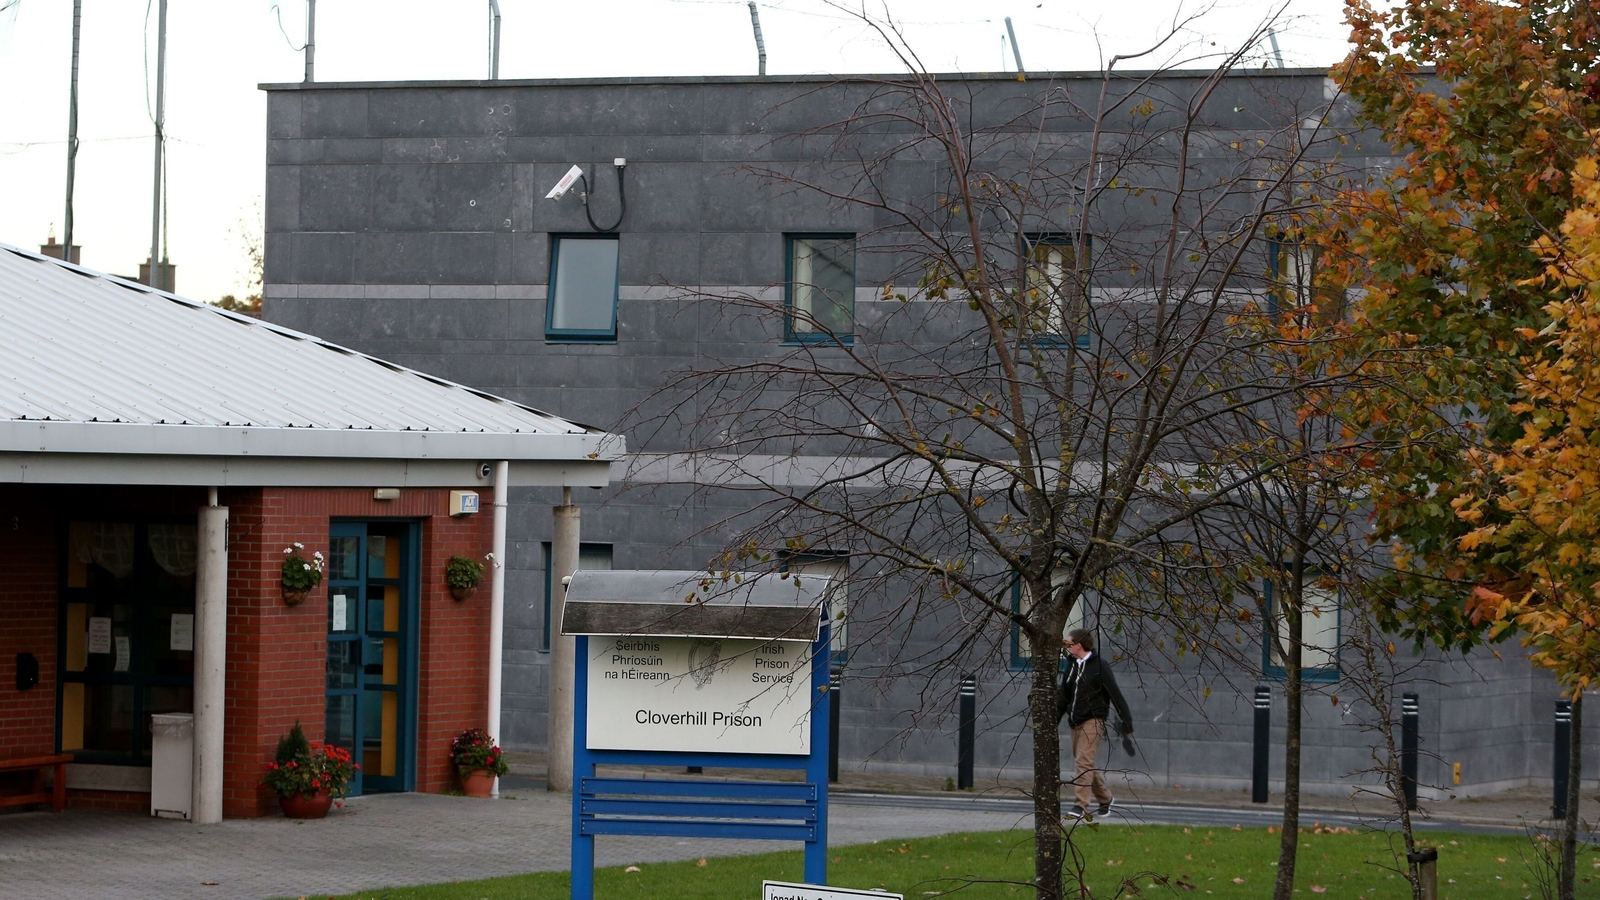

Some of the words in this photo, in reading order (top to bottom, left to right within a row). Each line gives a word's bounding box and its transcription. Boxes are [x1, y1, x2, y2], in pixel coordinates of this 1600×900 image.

[762, 644, 785, 655] Irish
[755, 658, 790, 669] Prison
[605, 672, 618, 680] na
[621, 667, 670, 681] hÉireann
[752, 672, 794, 684] Service
[635, 709, 707, 726] Cloverhill
[712, 712, 762, 727] Prison
